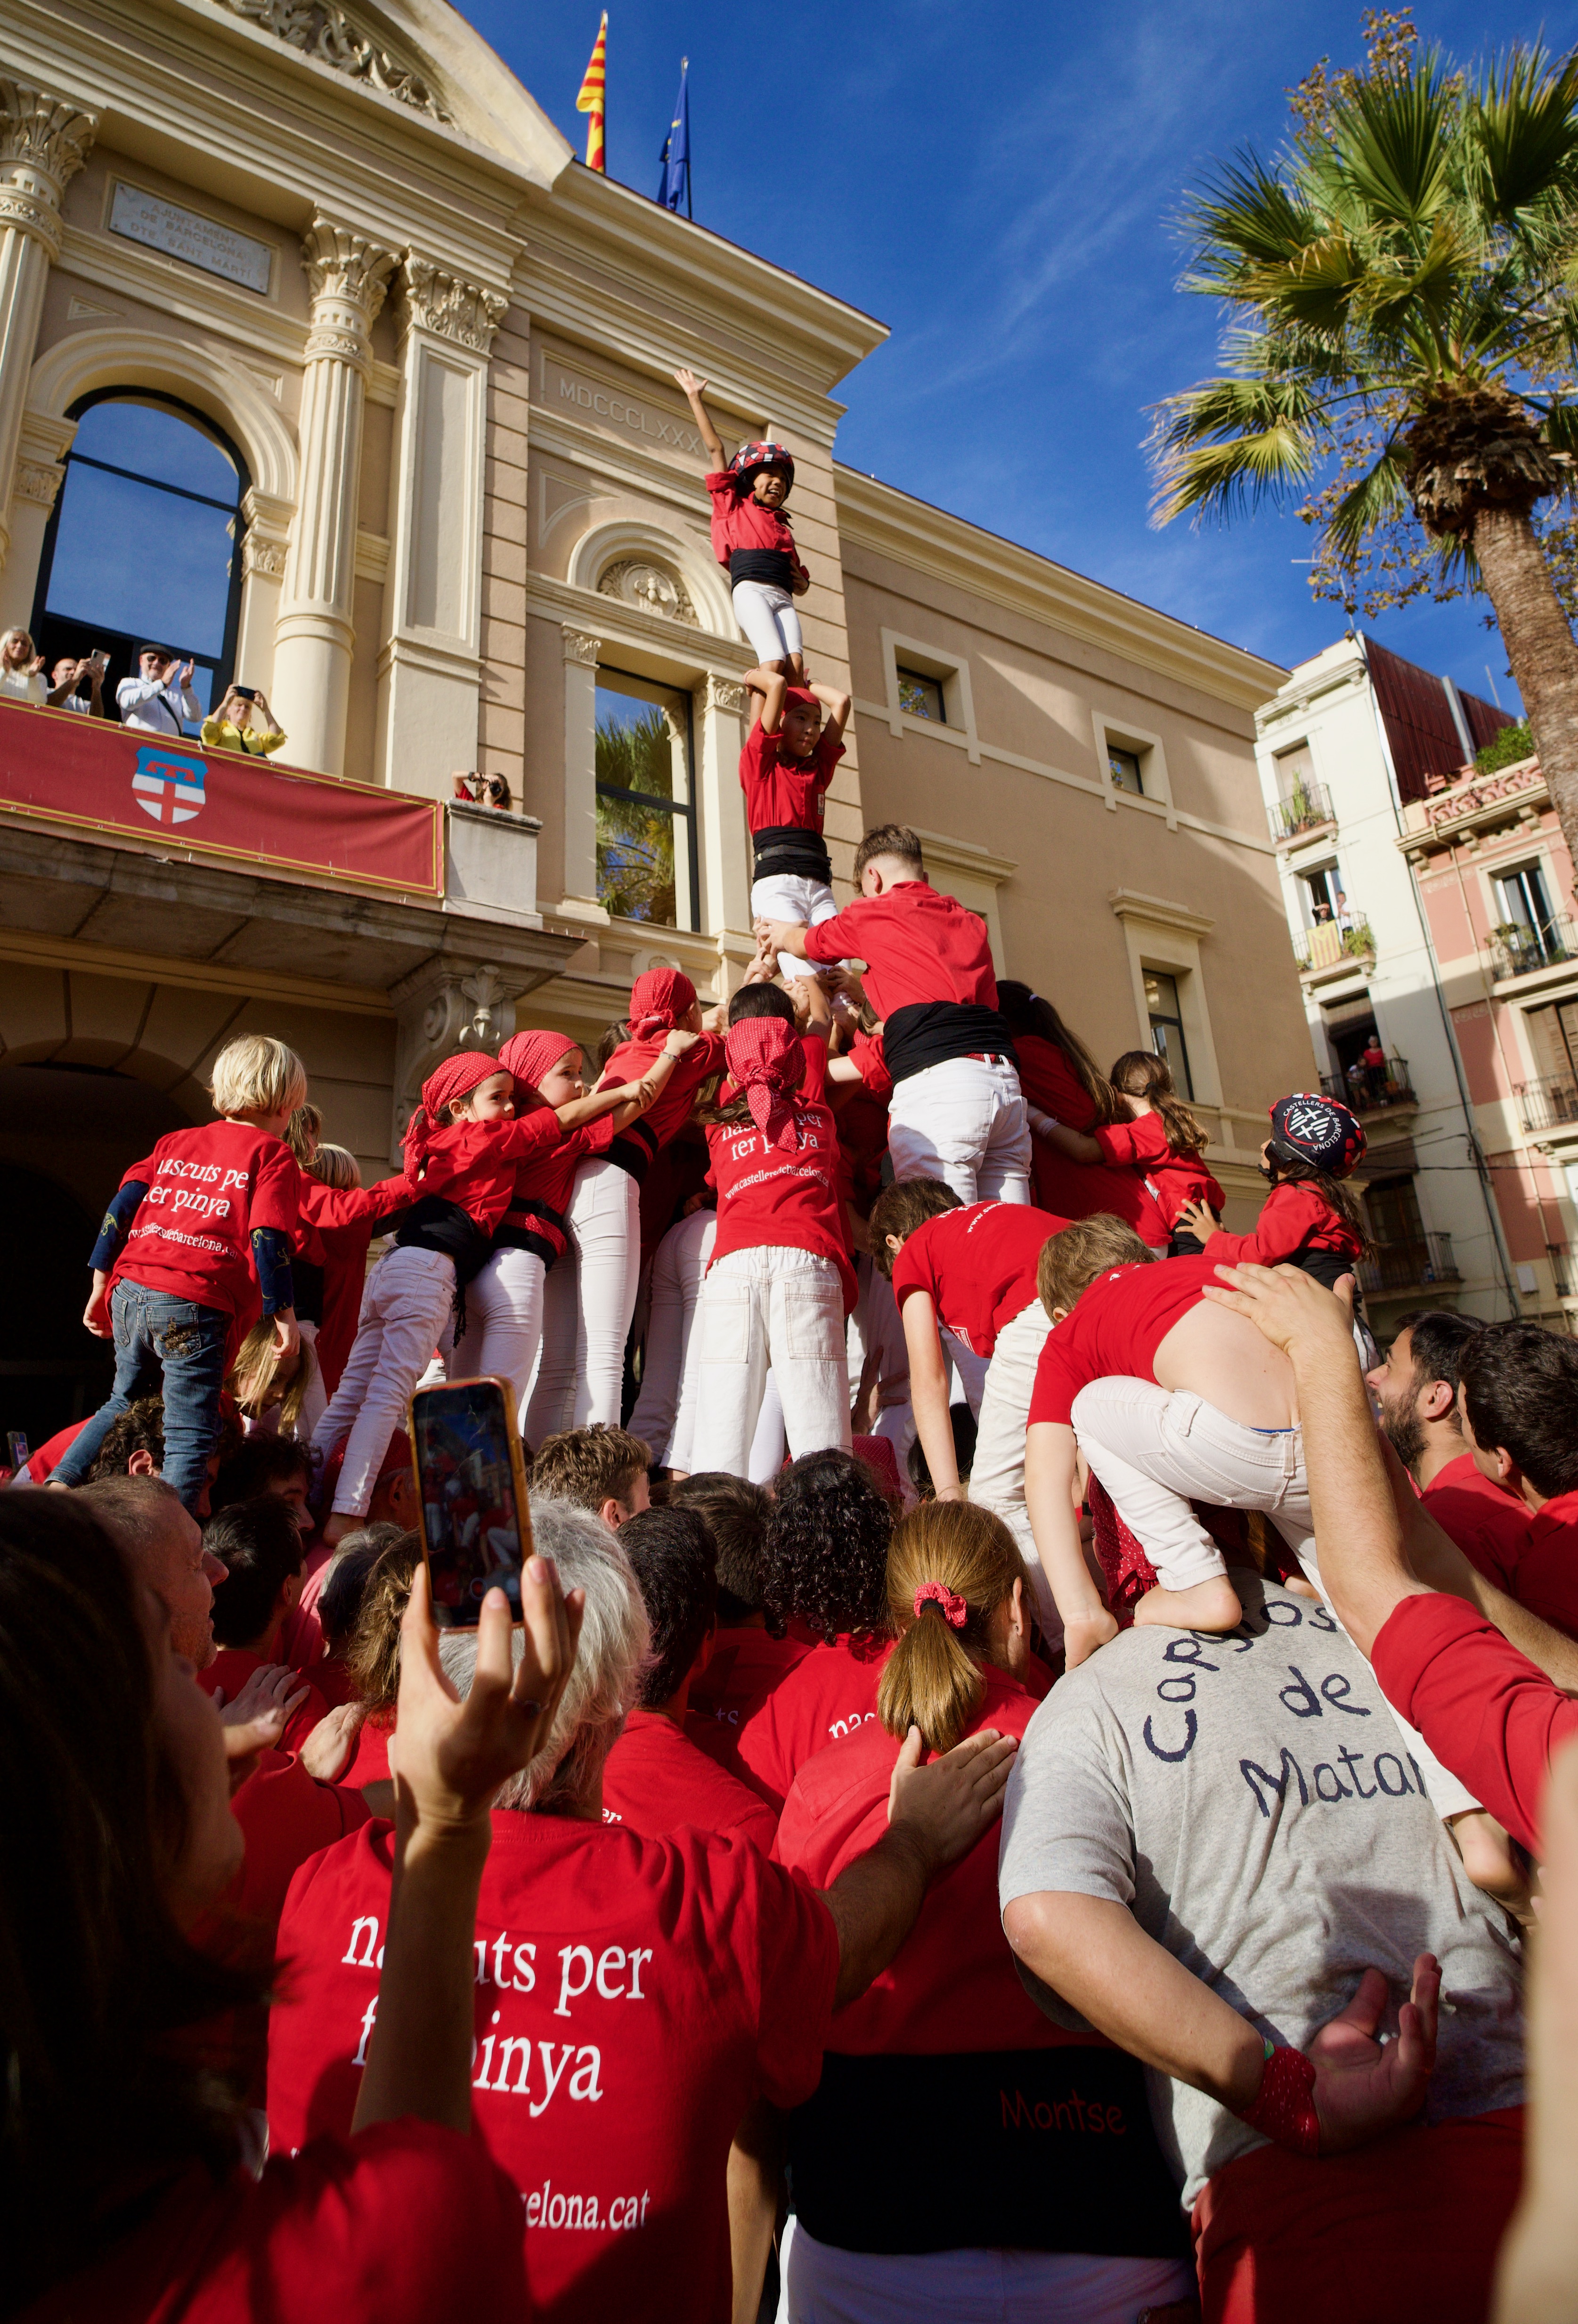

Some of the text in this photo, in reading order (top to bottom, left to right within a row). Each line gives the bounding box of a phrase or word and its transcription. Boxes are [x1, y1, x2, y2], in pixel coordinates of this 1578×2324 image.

[140, 209, 245, 260] DE BARCELONA
[151, 204, 237, 246] AJUNTAMENT
[167, 237, 203, 261] SANT
[761, 1131, 819, 1154] pya
[795, 1111, 822, 1128] per
[1283, 1100, 1342, 1151] CASTELLERS DE BARCELONA
[171, 1187, 231, 1218] pinya
[219, 1168, 250, 1191] pe
[1278, 1665, 1371, 1717] de
[1239, 1745, 1427, 1818] Matar
[554, 1944, 653, 2016] per
[472, 2010, 603, 2117] inya
[1000, 2088, 1127, 2136] Montse
